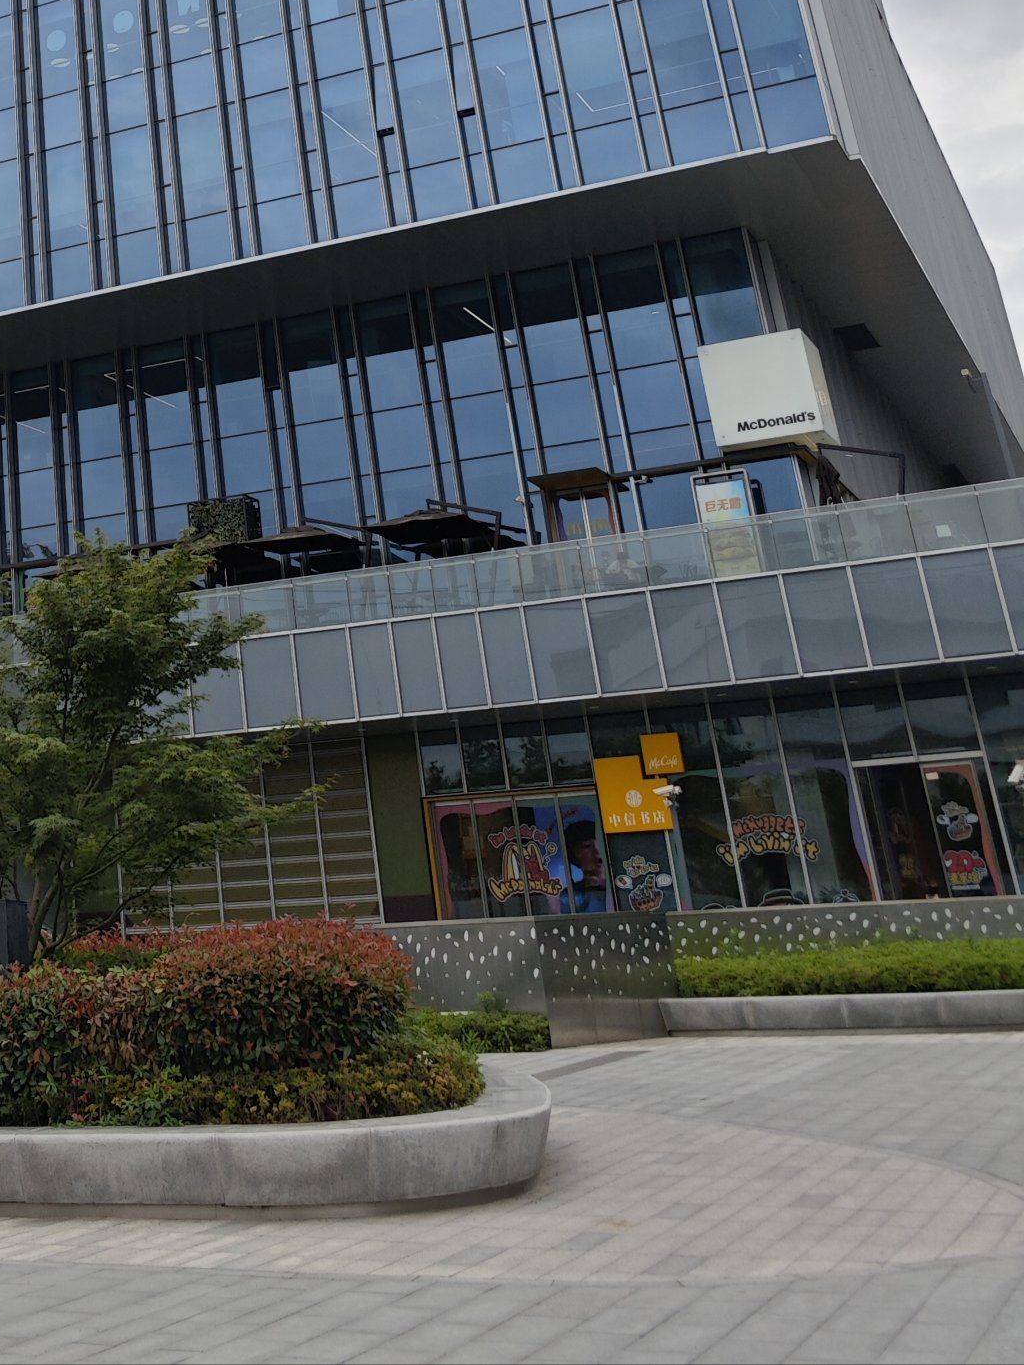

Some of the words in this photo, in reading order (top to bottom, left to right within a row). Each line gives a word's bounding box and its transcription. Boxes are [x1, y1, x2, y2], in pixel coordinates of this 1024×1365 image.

[737, 411, 816, 433] McDonald's
[608, 810, 666, 827] 中信书店
